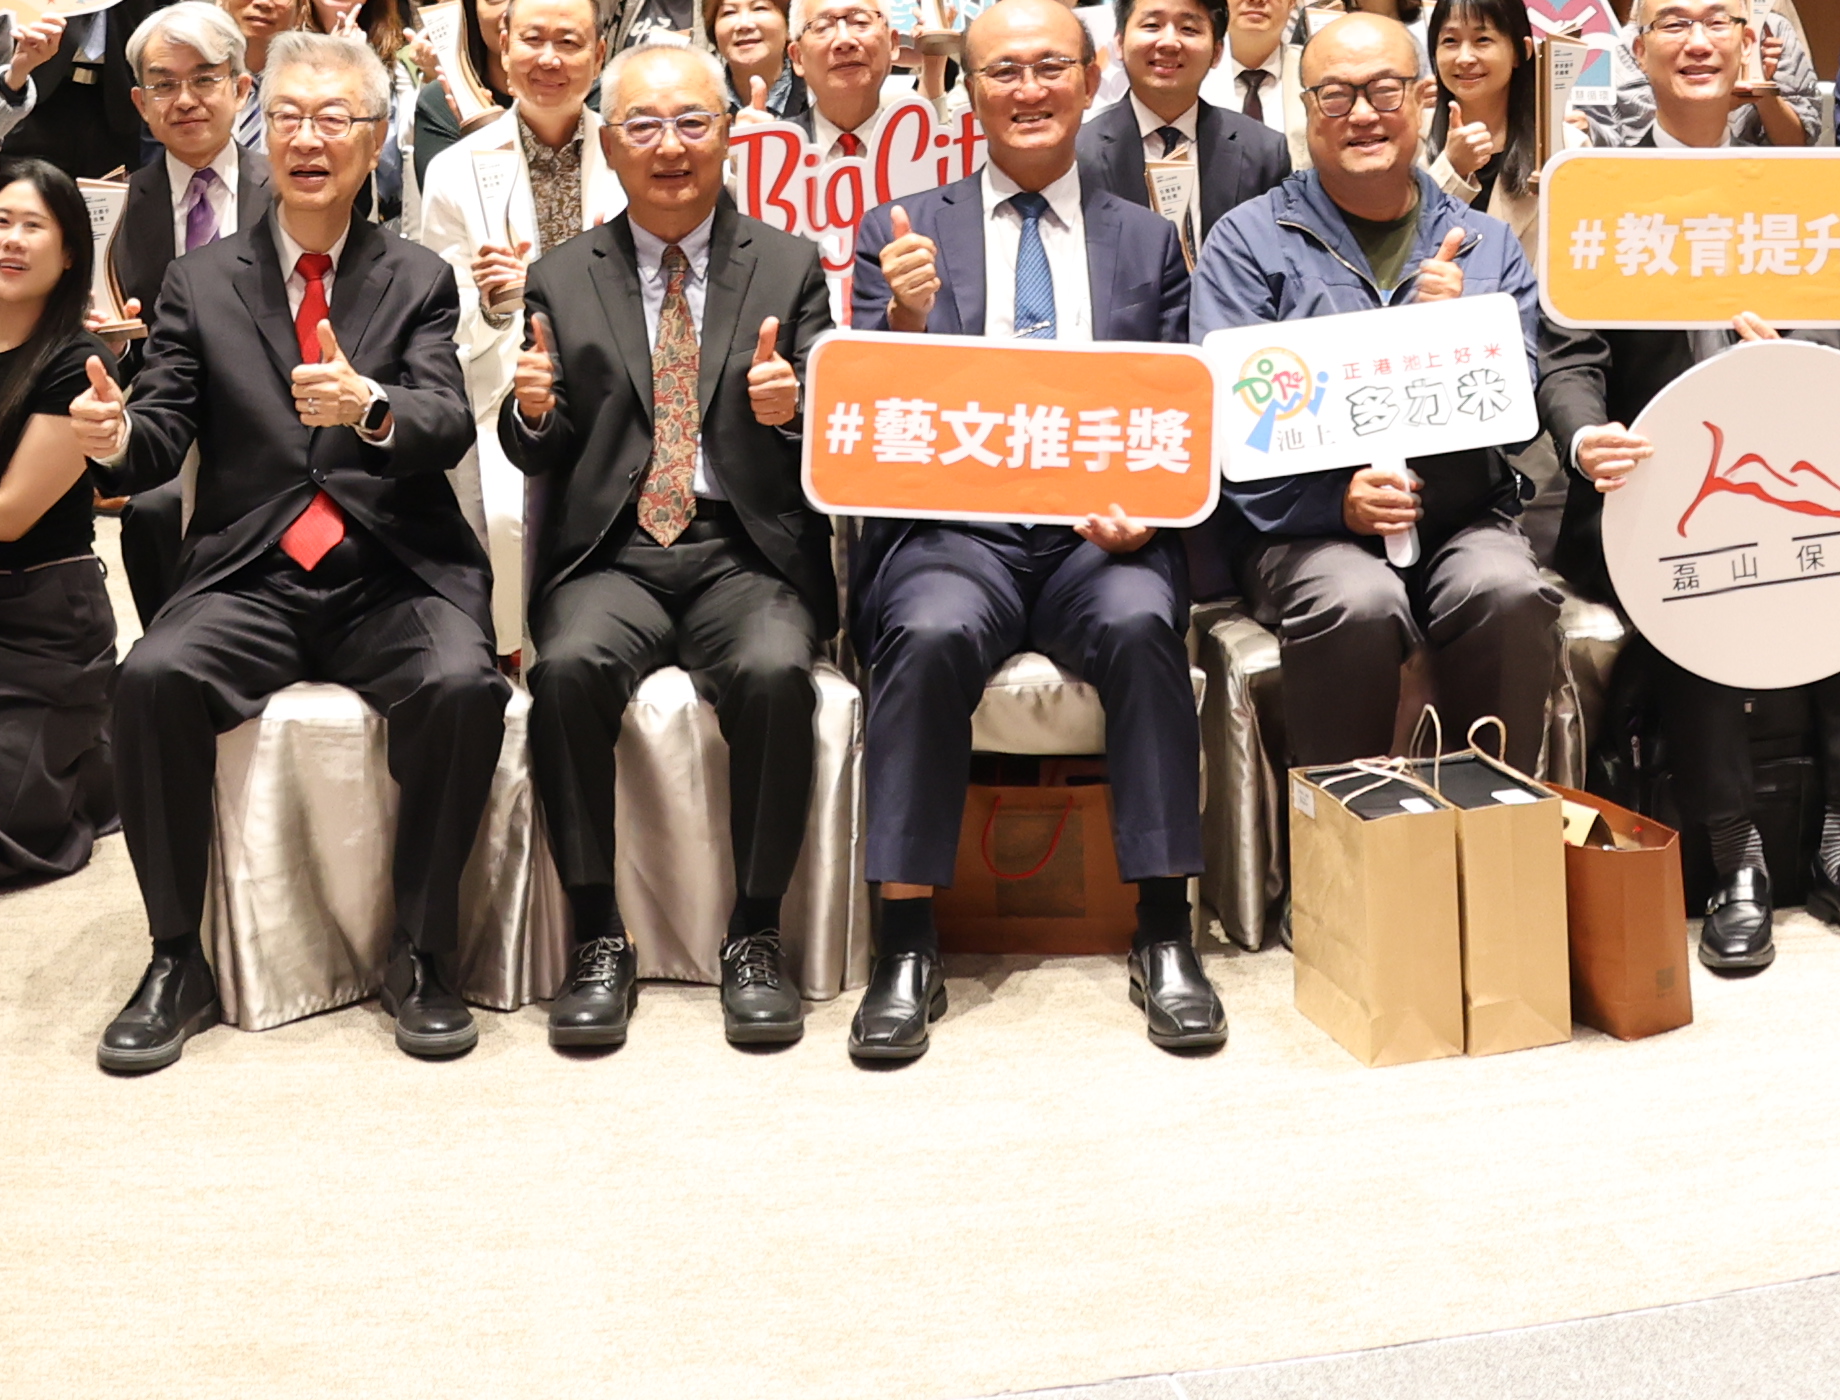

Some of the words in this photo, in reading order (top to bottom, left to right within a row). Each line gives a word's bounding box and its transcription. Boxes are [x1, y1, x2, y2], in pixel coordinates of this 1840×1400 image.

[1342, 343, 1502, 381] 正港池上好米
[825, 397, 1192, 473] #藝文推手獎
[1345, 368, 1512, 437] 多力米
